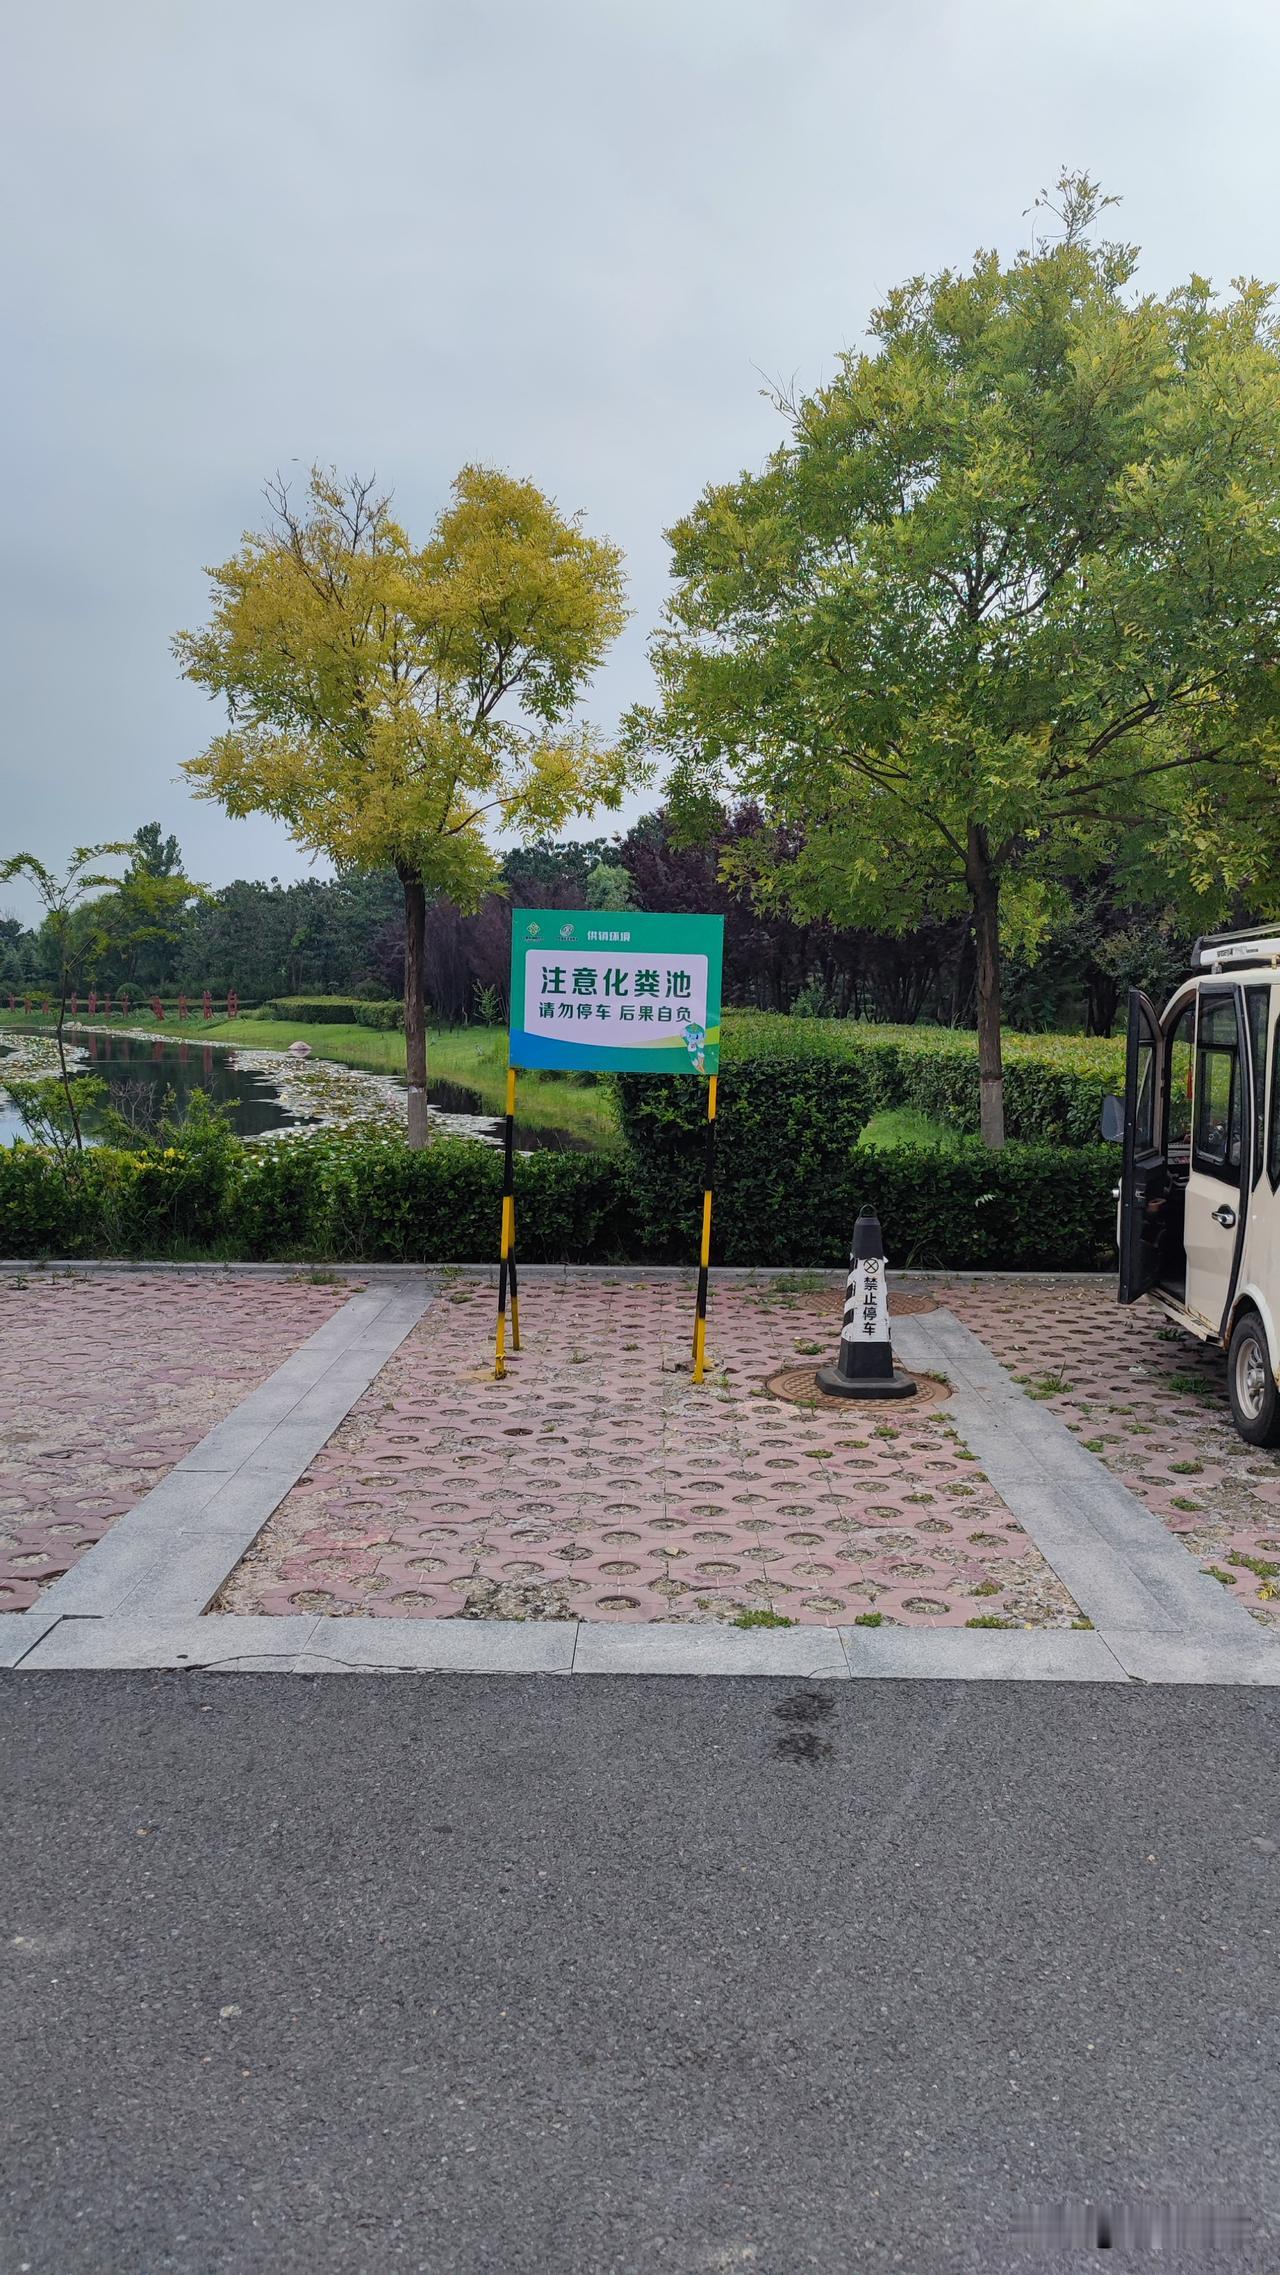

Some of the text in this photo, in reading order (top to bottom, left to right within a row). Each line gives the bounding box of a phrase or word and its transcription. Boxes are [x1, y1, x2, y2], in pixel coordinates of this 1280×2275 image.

[541, 966, 692, 998] 注意化粪池
[538, 1002, 692, 1022] 请勿停车 后果自负
[862, 1276, 878, 1336] 禁止停车
